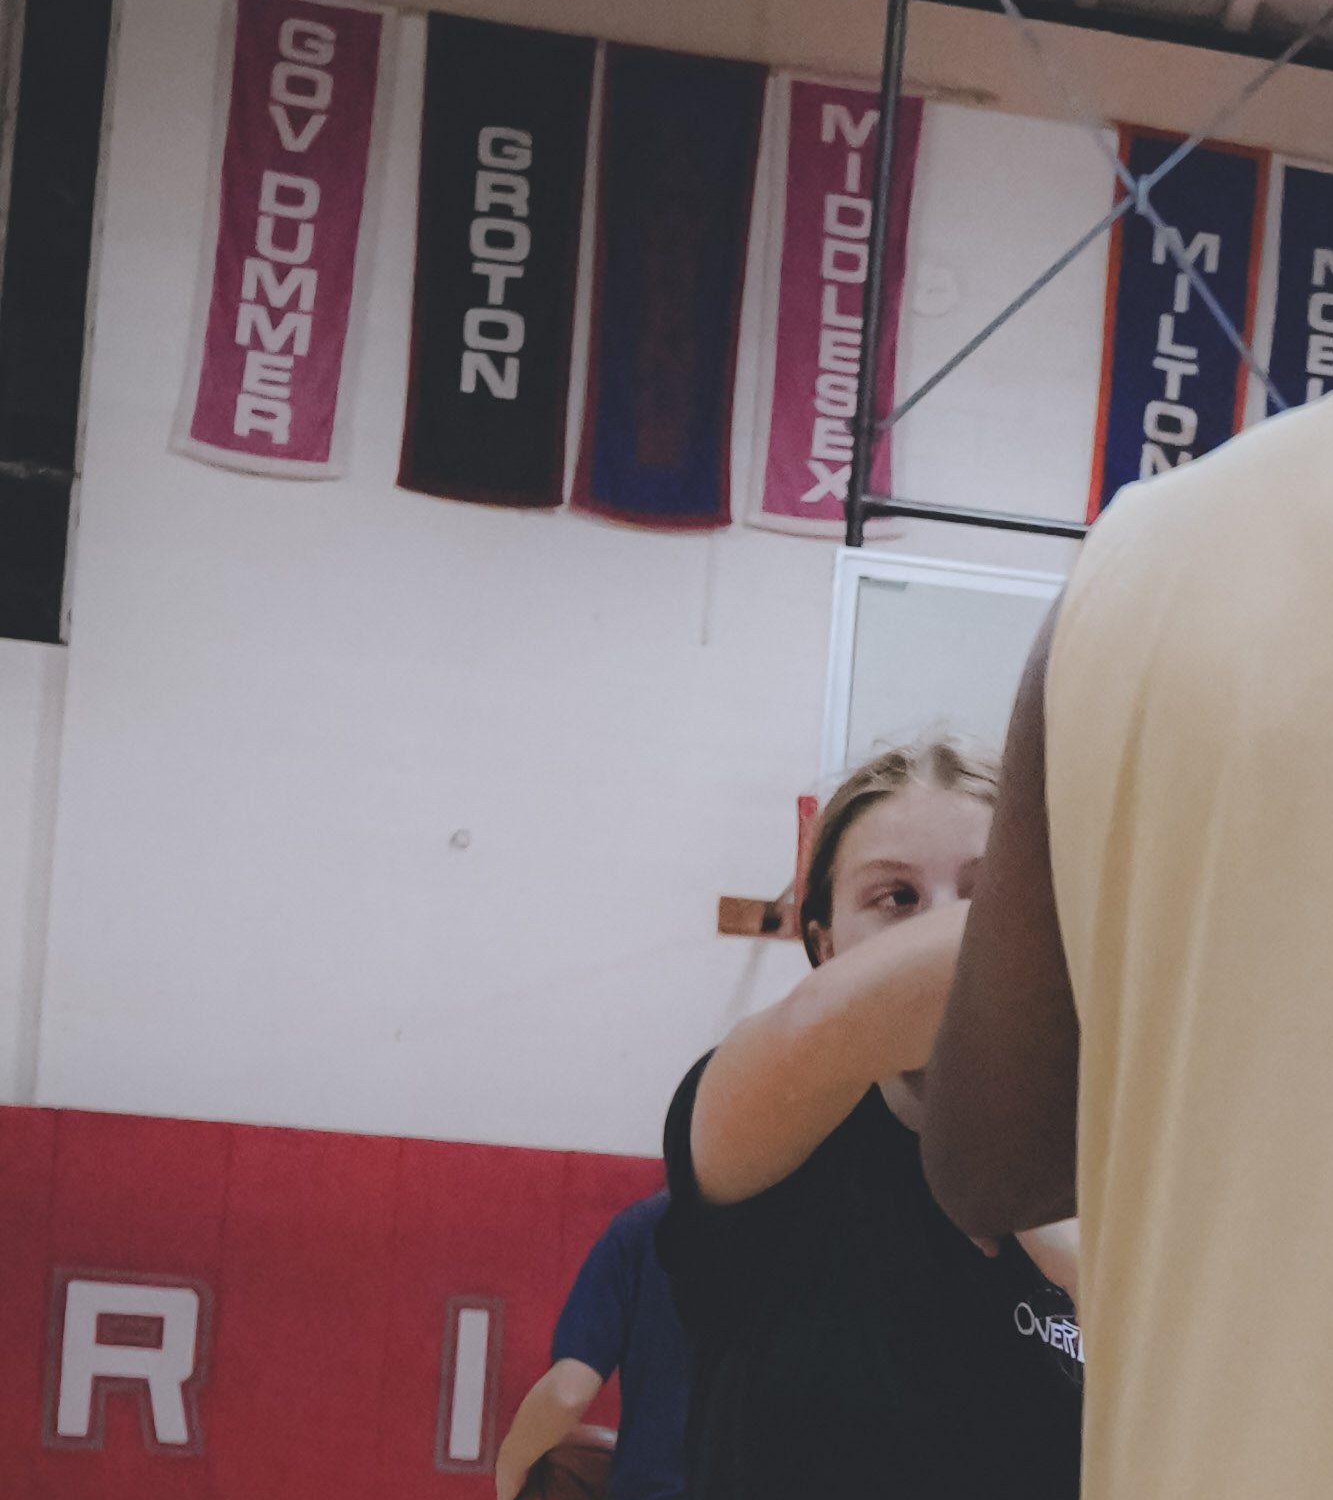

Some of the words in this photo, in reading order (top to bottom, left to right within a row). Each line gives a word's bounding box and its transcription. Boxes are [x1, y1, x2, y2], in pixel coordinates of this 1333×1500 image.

[267, 17, 338, 153] GOV
[233, 169, 321, 445] DUMMER
[459, 125, 533, 400] GROTON
[800, 103, 880, 503] MIDDLESEX
